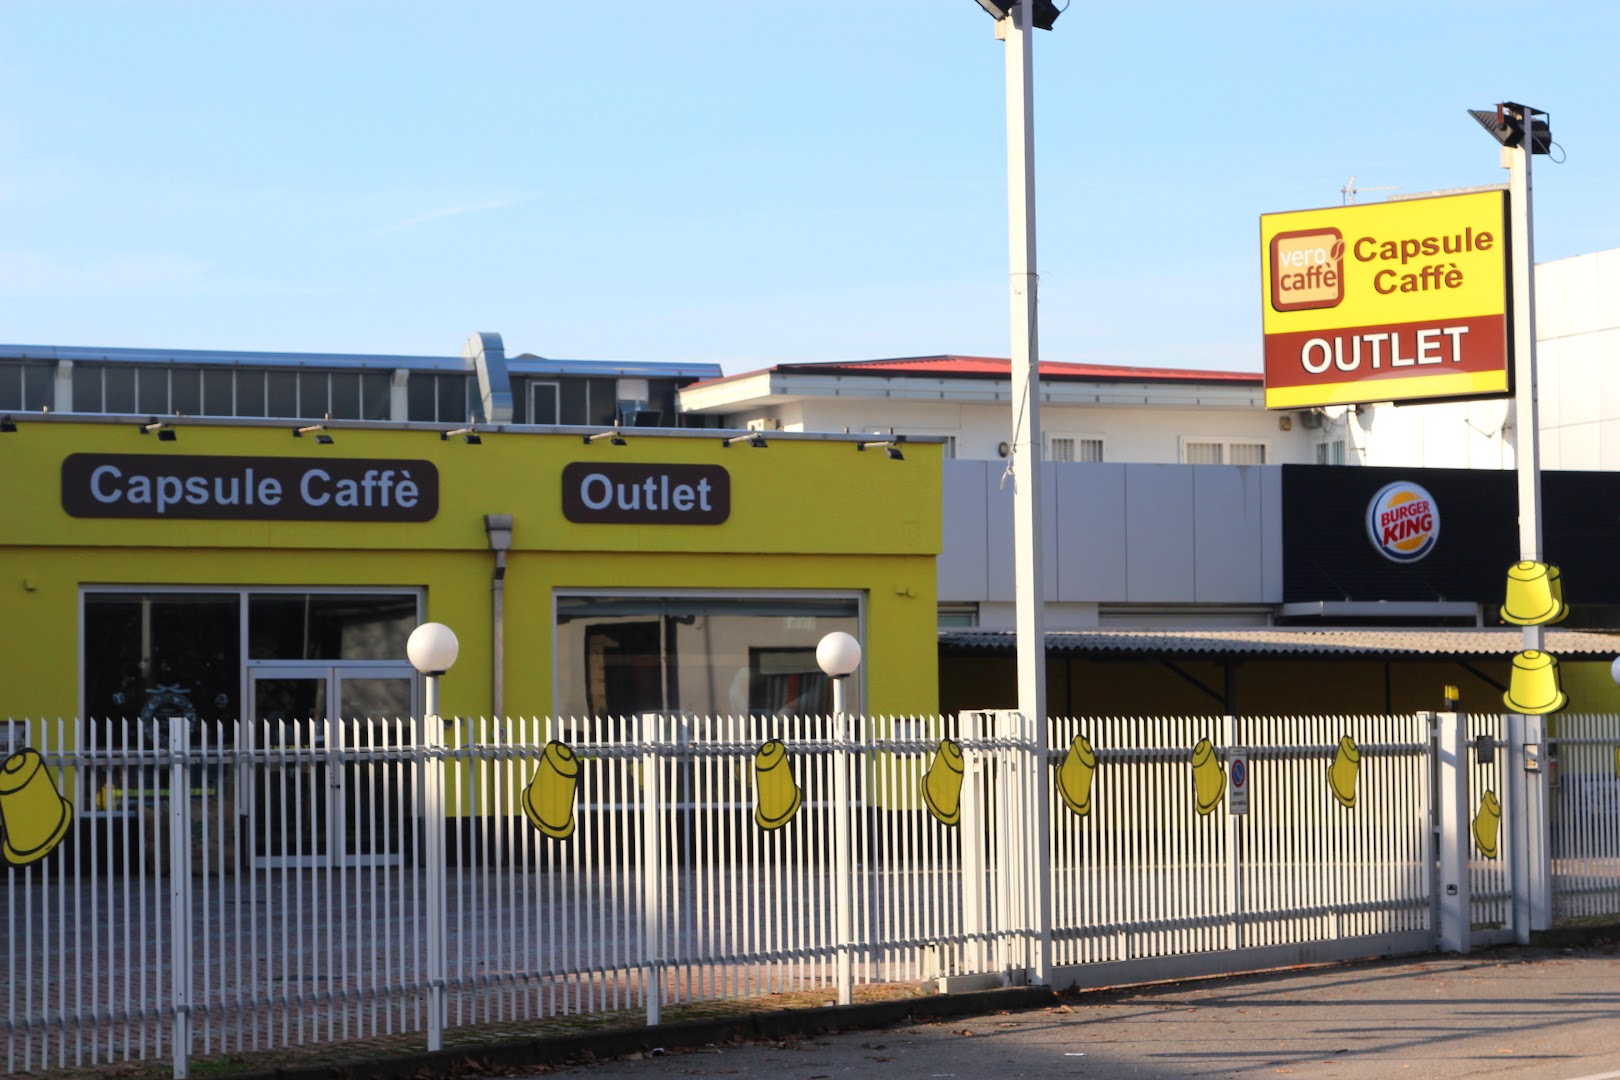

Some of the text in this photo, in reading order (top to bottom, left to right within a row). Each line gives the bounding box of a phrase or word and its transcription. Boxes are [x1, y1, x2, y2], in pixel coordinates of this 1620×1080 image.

[1280, 248, 1326, 268] vero
[1353, 227, 1494, 264] Capsule
[1281, 262, 1336, 291] caffè
[1373, 263, 1463, 294] Caffè
[1301, 326, 1469, 374] OUTLET
[90, 465, 419, 513] Capsule Caffè
[580, 473, 711, 511] Outlet
[1381, 501, 1430, 527] BURGER
[1382, 514, 1432, 546] KING
